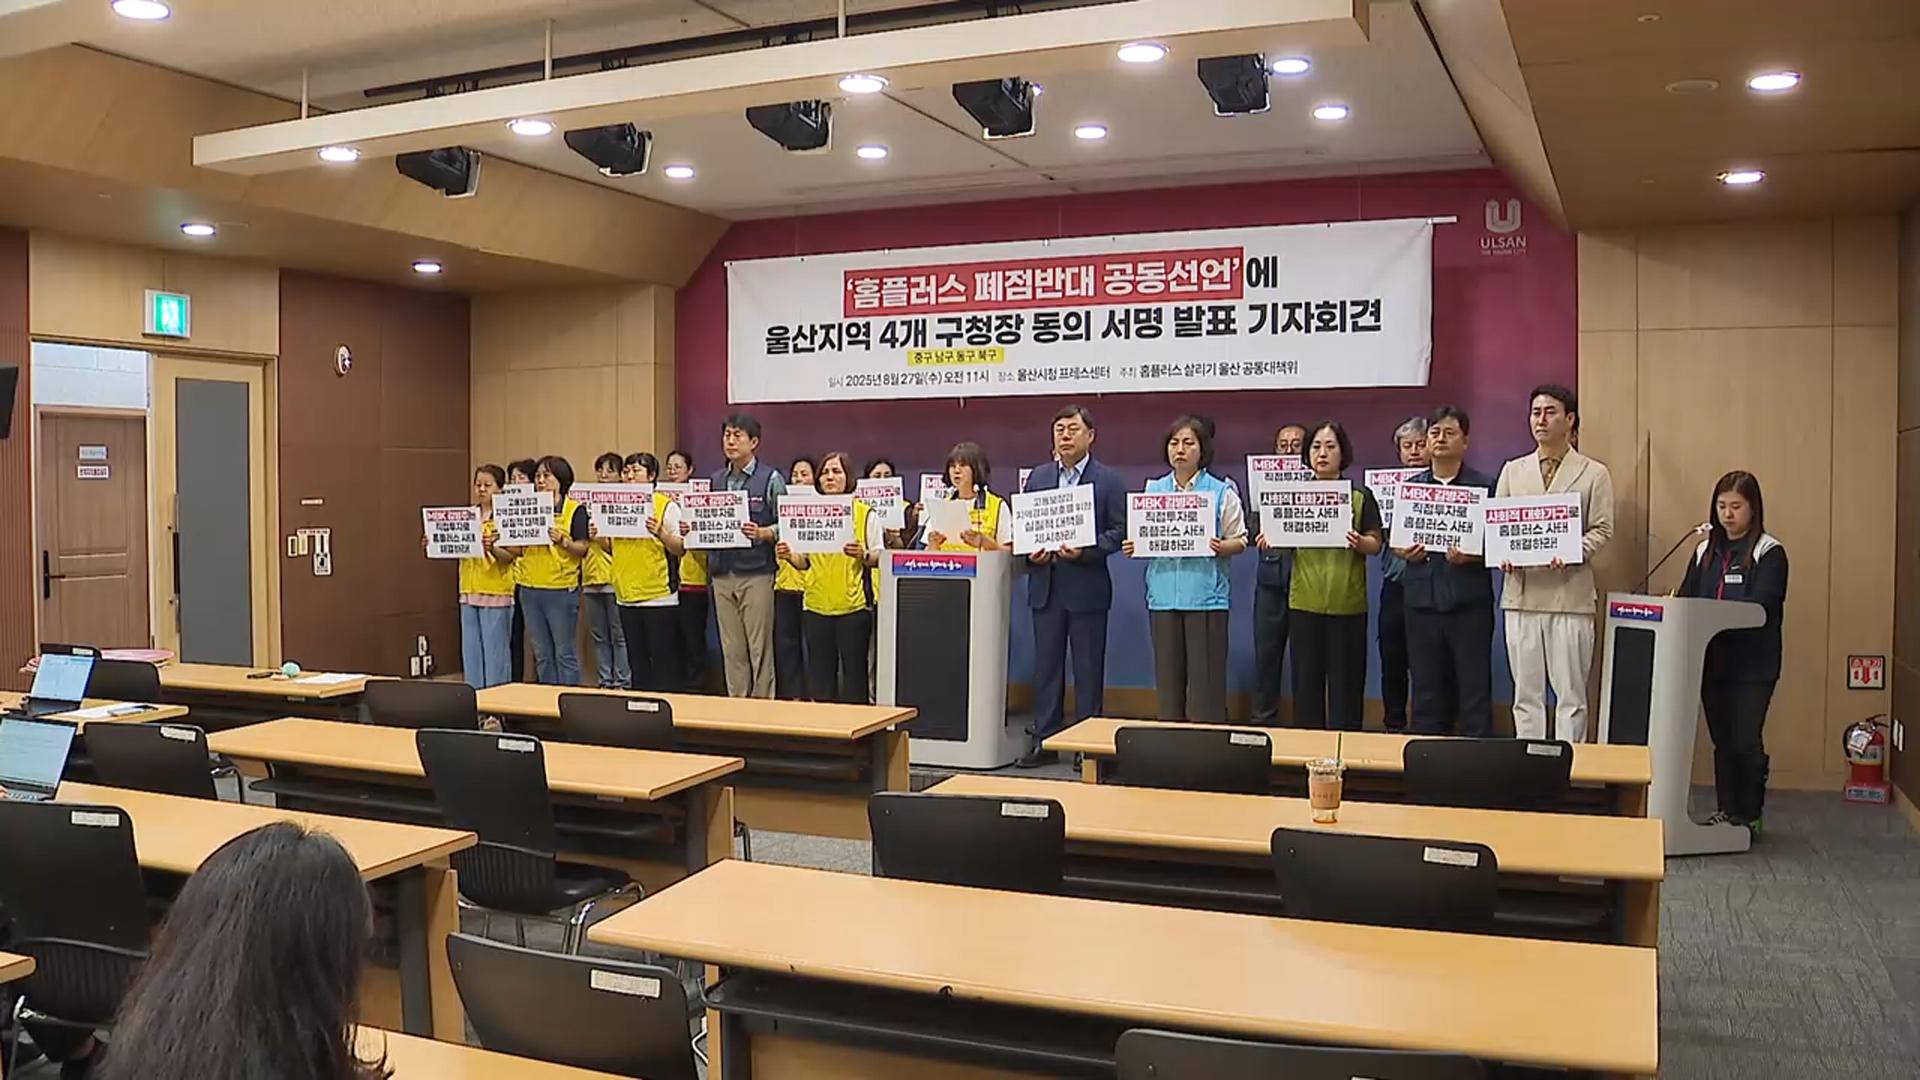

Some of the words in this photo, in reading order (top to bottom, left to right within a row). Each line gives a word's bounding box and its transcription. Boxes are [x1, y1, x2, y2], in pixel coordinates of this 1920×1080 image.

[1481, 236, 1526, 249] ULSAN
[974, 265, 1095, 302] 폐점반대
[766, 321, 871, 355] 울산지역
[879, 317, 927, 350] 4개
[935, 313, 1025, 348] 구청장
[1032, 310, 1091, 342] 동의
[1101, 306, 1164, 341] 서명
[1174, 304, 1238, 338] 발표
[1248, 298, 1382, 335] 기자회견
[913, 351, 932, 364] 중구
[935, 350, 954, 363] 남구
[956, 349, 975, 363] 동구
[978, 348, 998, 362] 북구
[1017, 368, 1058, 382] 울산시청
[1059, 366, 1111, 381] 프레스센터
[1139, 362, 1182, 379] 홈플러스
[1183, 361, 1217, 377] 살리기
[1218, 361, 1241, 377] 울산
[1242, 359, 1299, 376] 공동대책위
[1253, 458, 1281, 471] MBK
[1371, 472, 1400, 485] MBK
[1261, 492, 1293, 506] 사회적
[1401, 485, 1432, 501] MBK
[1134, 496, 1163, 509] MBK
[1145, 510, 1198, 523] 직접투자로
[1273, 507, 1315, 519] 홈플러스
[1316, 507, 1339, 519] 사태
[1412, 502, 1468, 518] 직접투자로
[1487, 508, 1520, 524] 사회적
[1522, 504, 1580, 521] 대화기구로
[1139, 525, 1182, 538] 홈플러스
[1183, 525, 1205, 537] 사태
[1283, 521, 1329, 533] 해결하라!
[1403, 516, 1449, 532] 홈플러스
[1449, 520, 1474, 534] 사태
[1499, 523, 1543, 537] 홈플러스
[1545, 521, 1569, 534] 사태
[1149, 538, 1194, 551] 해결하라!
[1412, 531, 1461, 547] 해결하라!
[1510, 537, 1558, 551] 해결하라!
